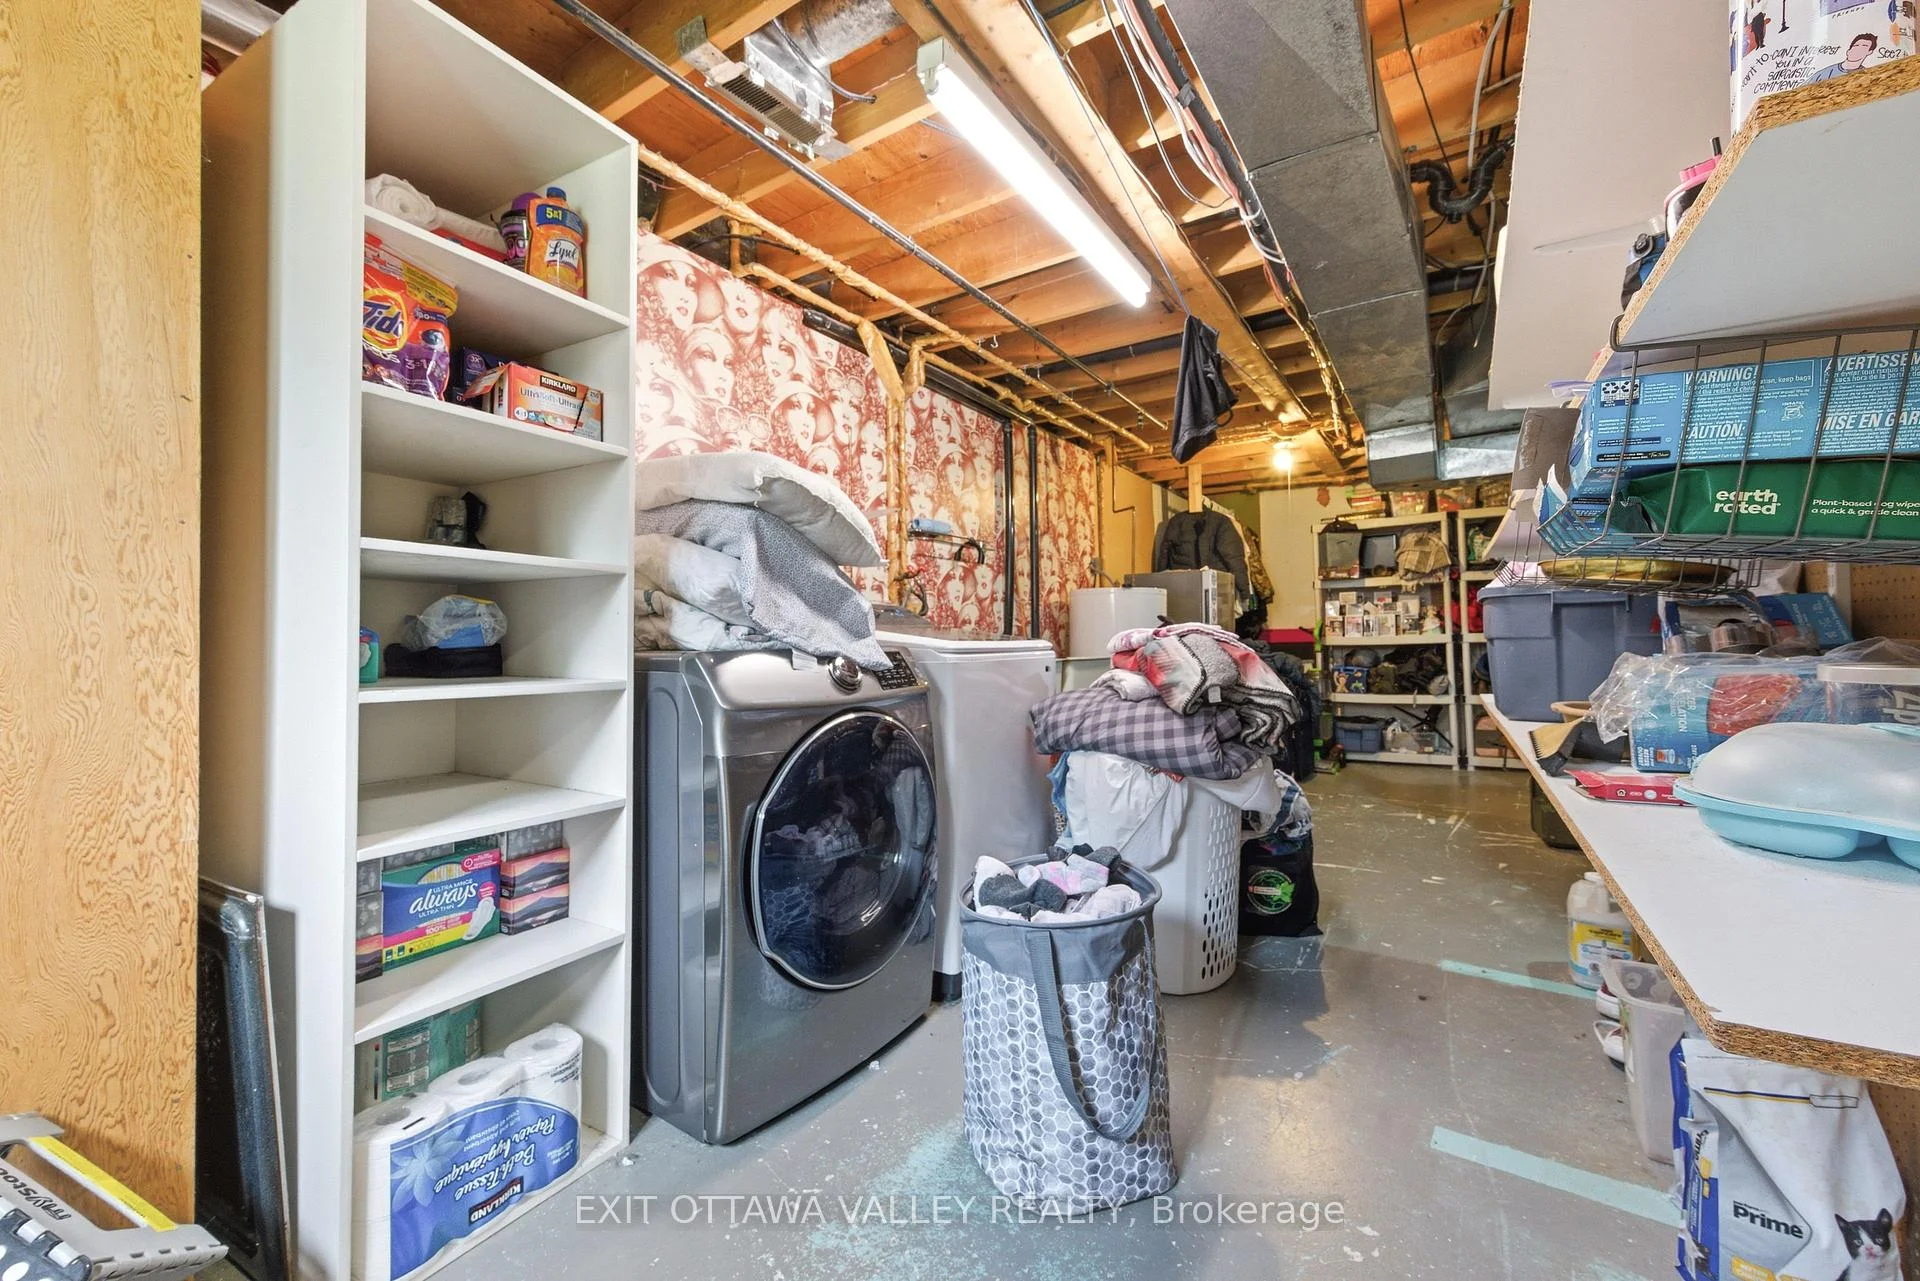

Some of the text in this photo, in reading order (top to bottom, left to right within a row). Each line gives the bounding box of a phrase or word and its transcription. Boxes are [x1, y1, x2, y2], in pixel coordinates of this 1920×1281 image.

[549, 240, 576, 259] Lysol
[541, 376, 577, 393] KIRKLAND
[1816, 414, 1857, 431] MISE
[1858, 413, 1883, 429] EN
[1716, 488, 1779, 503] earth
[1812, 499, 1872, 507] Plant-based
[1714, 502, 1777, 515] rated
[1819, 507, 1846, 516] quick
[1857, 509, 1890, 517] genle
[409, 882, 479, 915] always
[418, 907, 440, 918] ULTRA
[512, 1113, 556, 1143] Papier
[500, 1143, 536, 1179] Bath
[454, 1165, 500, 1201] Tissue
[470, 1183, 521, 1222] KIRKLAND
